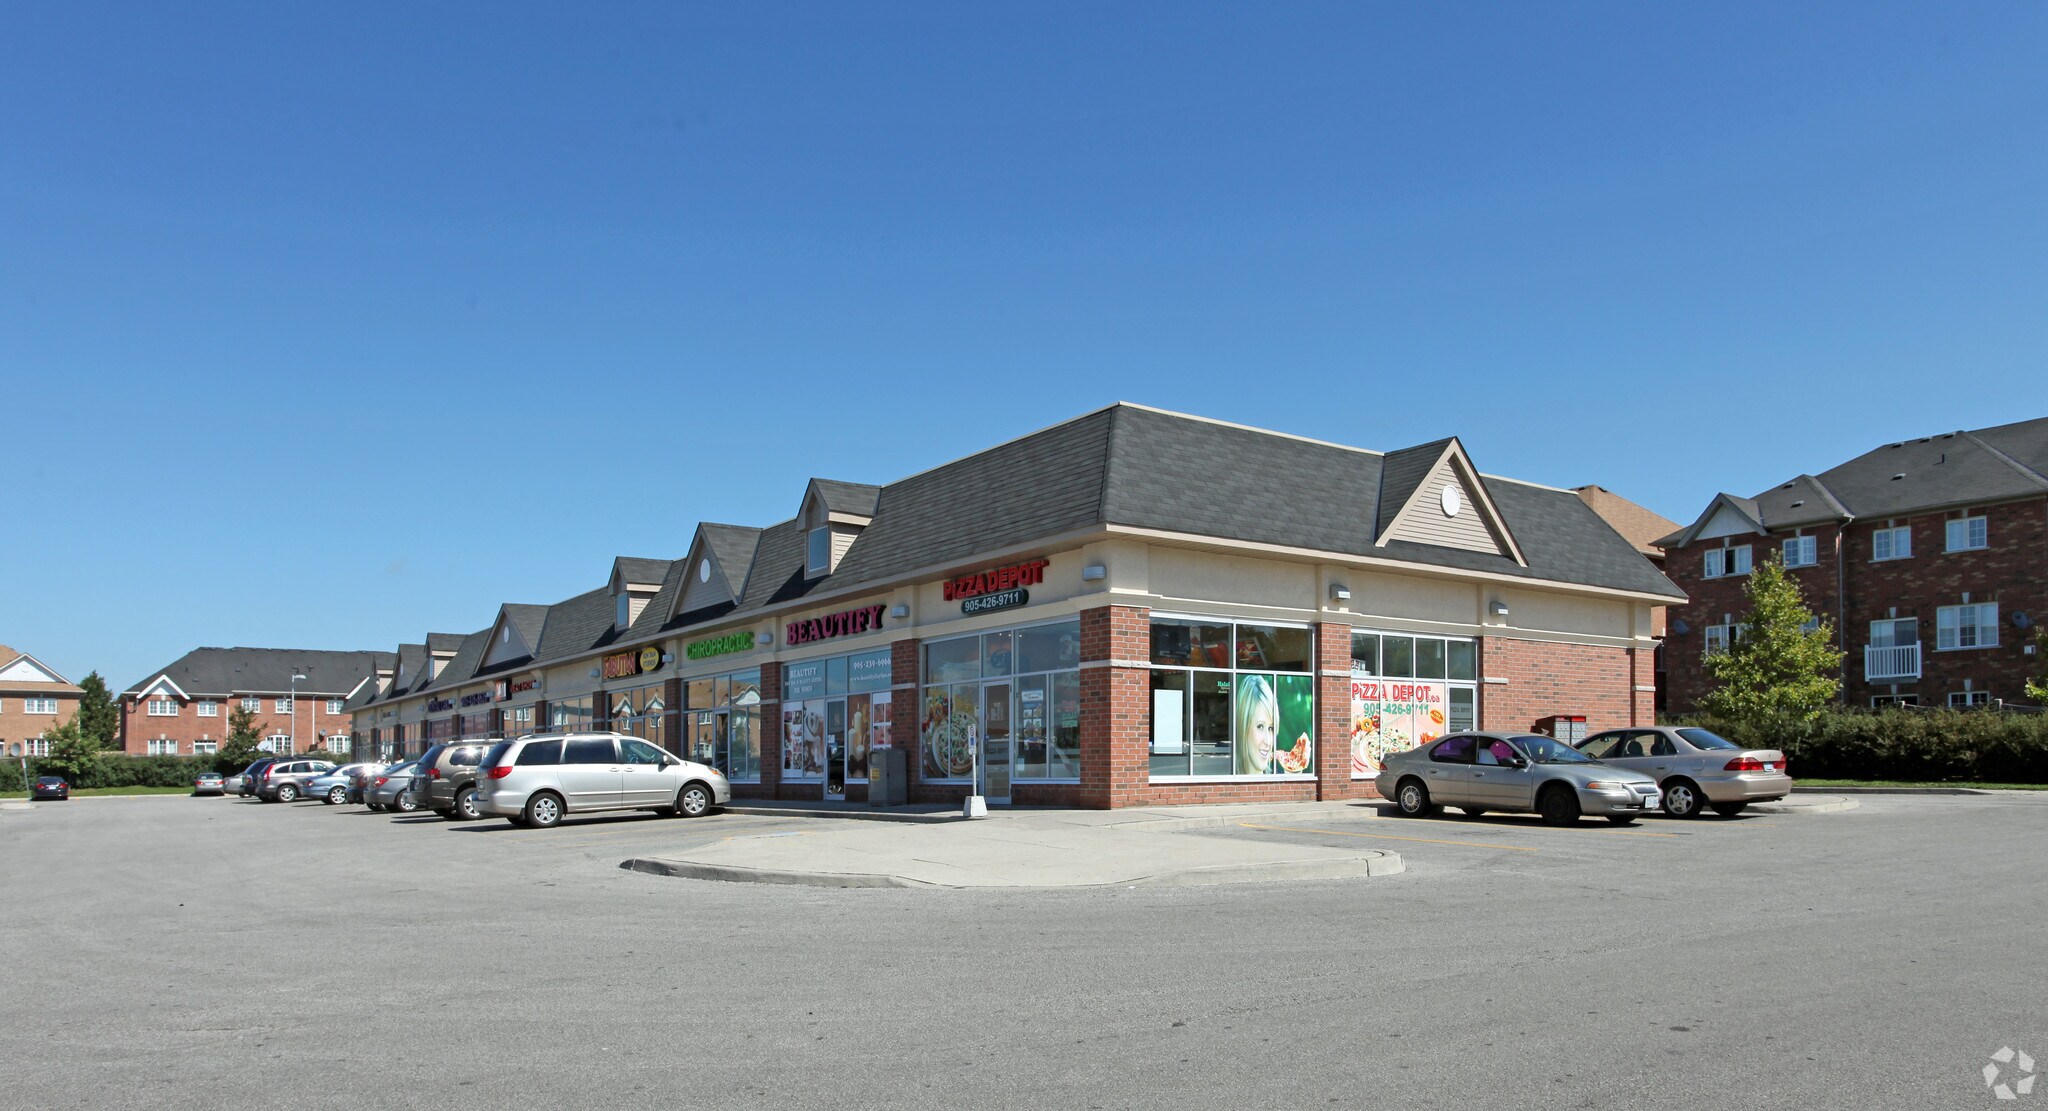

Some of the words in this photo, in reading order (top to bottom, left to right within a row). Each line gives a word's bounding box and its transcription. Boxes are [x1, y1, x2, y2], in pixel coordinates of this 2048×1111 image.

[986, 562, 1044, 591] DEPOT
[965, 592, 1019, 612] 905-426-9711
[787, 604, 886, 645] BEAUTIFY
[687, 632, 754, 660] CHIROPRACTIC
[790, 666, 817, 678] BEAUTIFY
